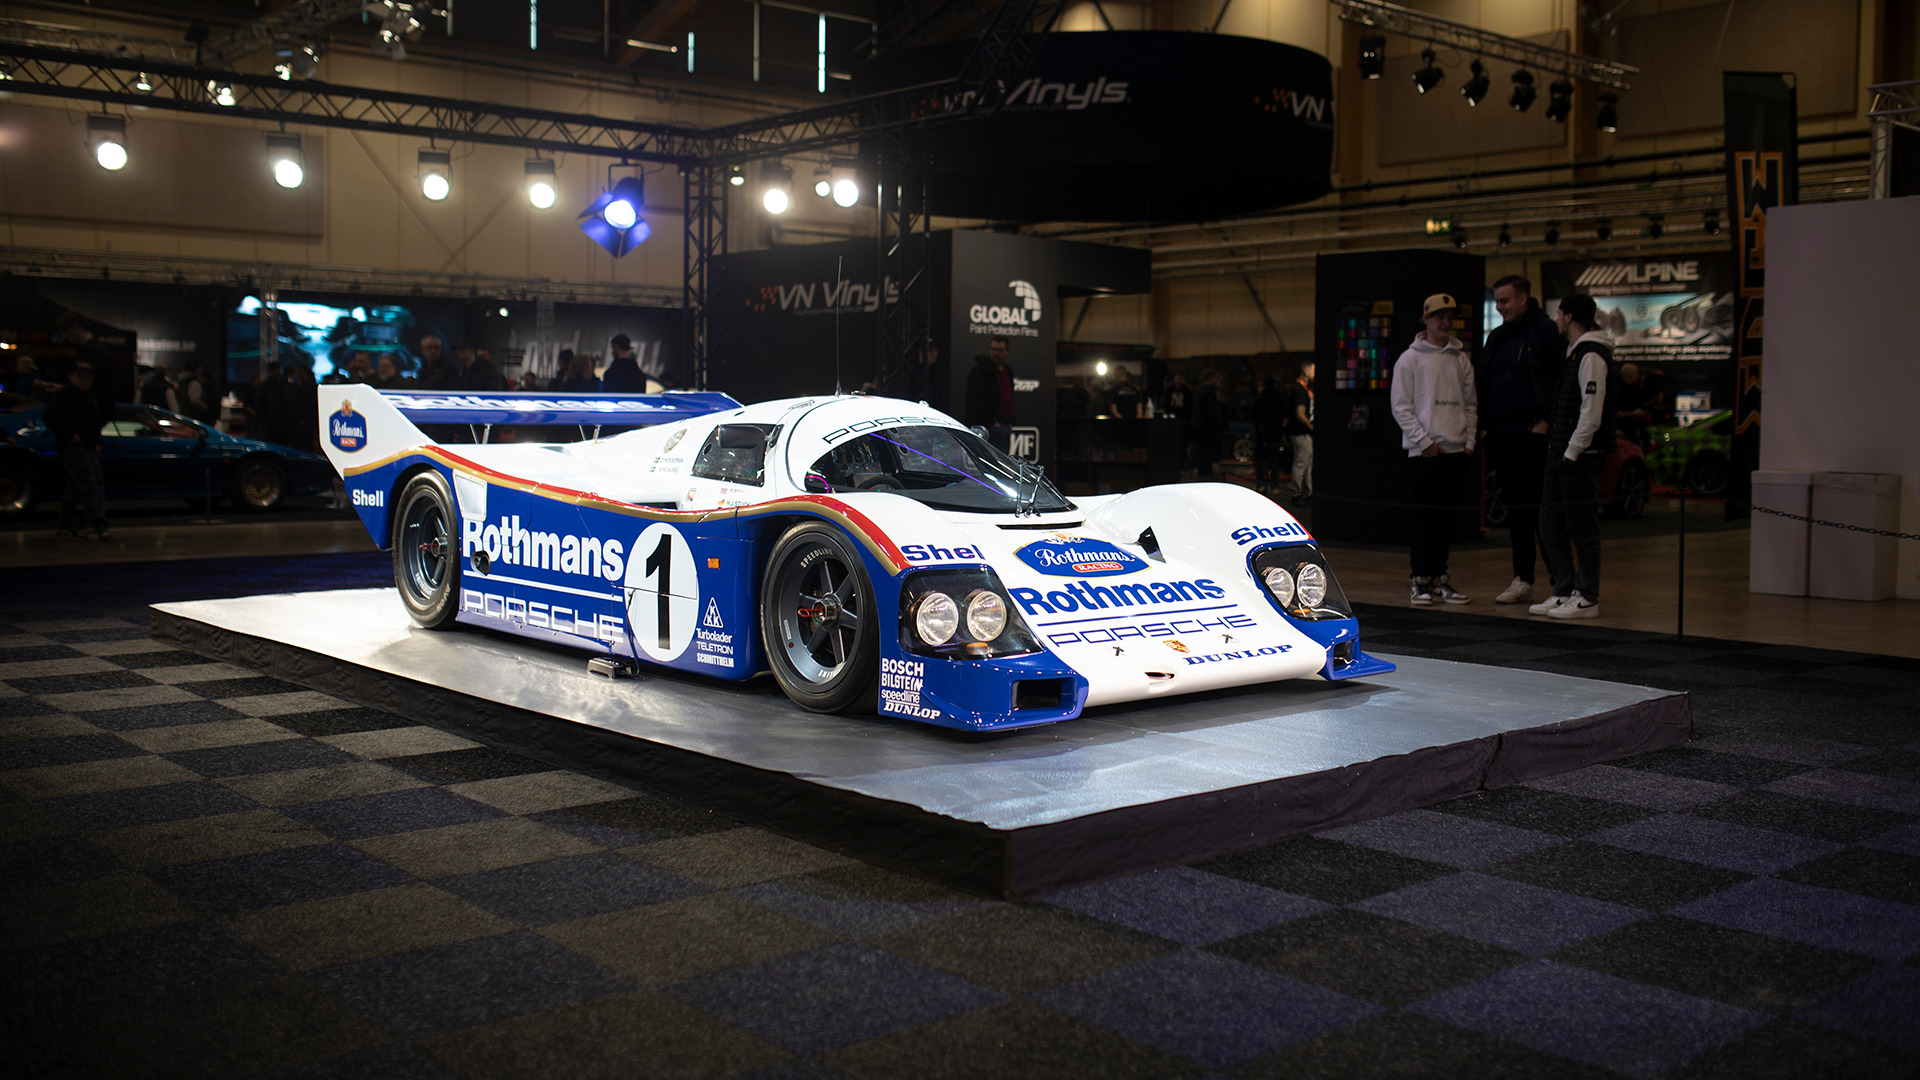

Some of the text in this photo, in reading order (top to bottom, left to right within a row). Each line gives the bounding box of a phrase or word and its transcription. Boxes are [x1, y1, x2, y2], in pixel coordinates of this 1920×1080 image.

[998, 77, 1128, 110] Vinyls
[1291, 91, 1325, 121] VN
[1611, 261, 1699, 284] ALPINE
[778, 283, 816, 310] VN
[970, 304, 1029, 325] GLOBAL
[970, 323, 1039, 337] Paint Protection Films
[382, 394, 653, 412] Rothmans
[352, 489, 384, 507] Shell
[1231, 523, 1306, 546] Shell
[463, 515, 624, 581] Rothmans
[800, 548, 833, 568] SPEEDLINE
[900, 544, 986, 561] Shel
[1077, 562, 1119, 571] RACING
[646, 533, 672, 650] 1
[1007, 577, 1227, 616] Rothmans
[463, 589, 624, 643] PORSCHE
[696, 628, 733, 643] Turbolader
[1046, 614, 1258, 648] PORSCHE
[696, 641, 734, 655] TELETRON
[1183, 644, 1293, 666] DUNLOP
[882, 657, 924, 677] BOSCH
[881, 673, 923, 692] BILSTEIN
[881, 689, 920, 704] speedline
[883, 702, 941, 720] DUNLOP
